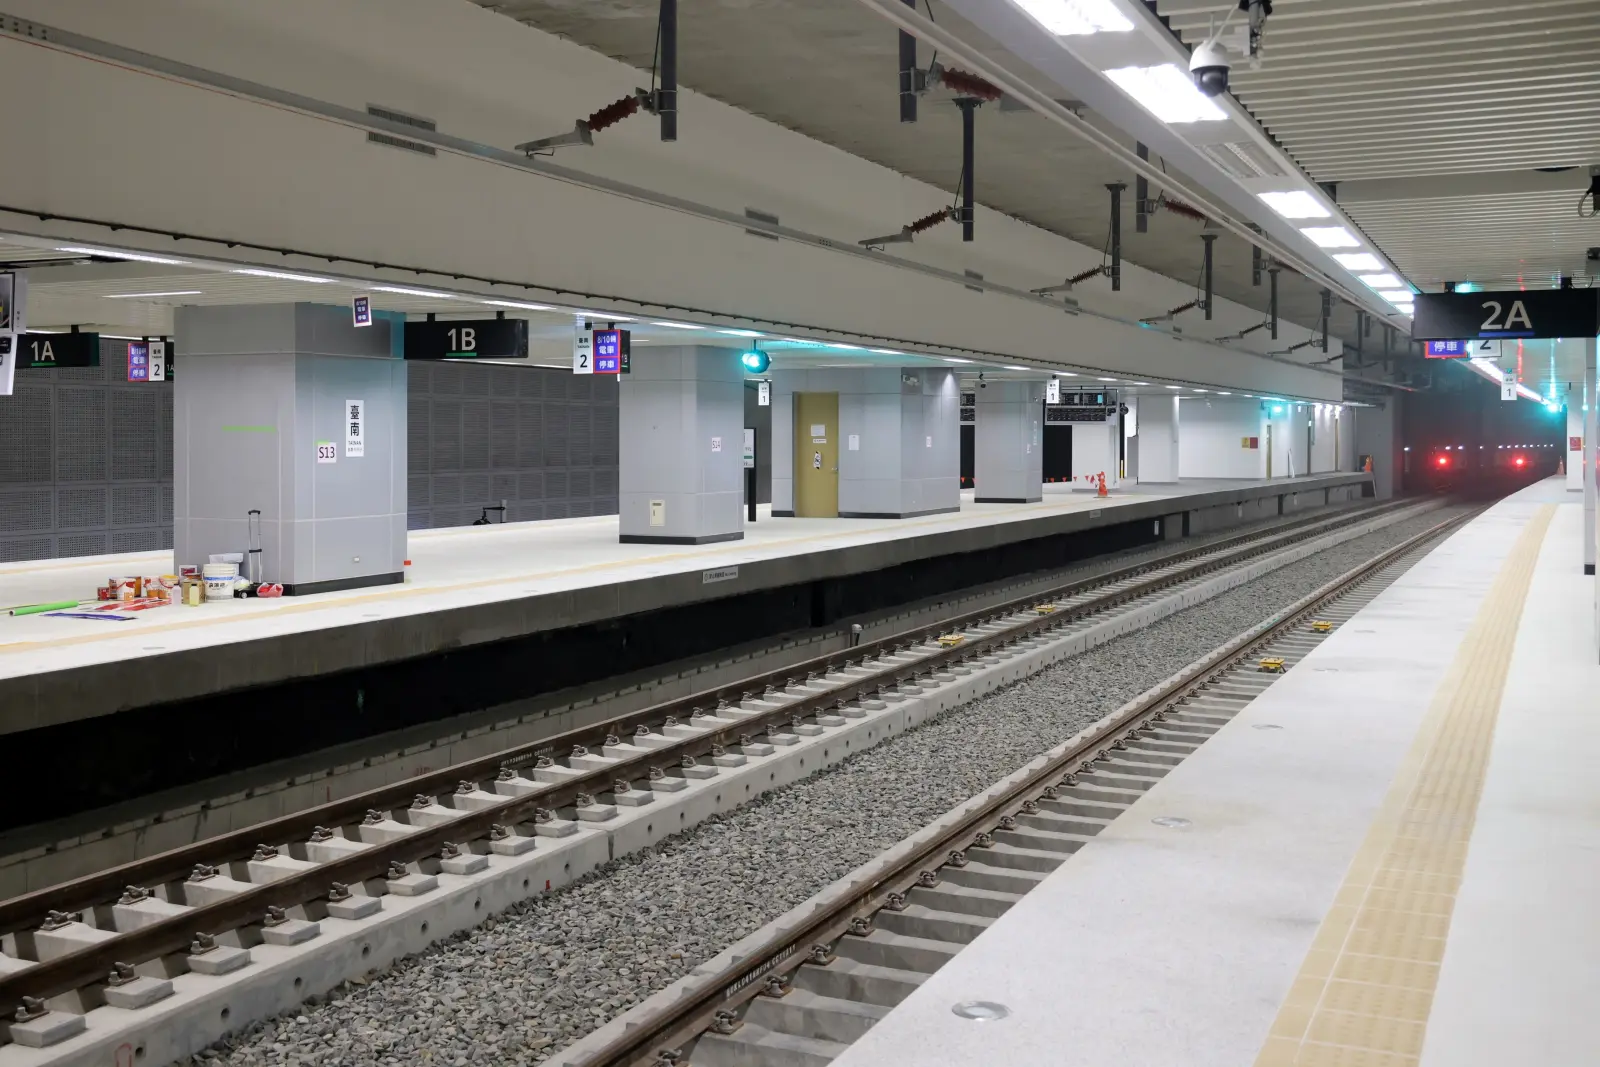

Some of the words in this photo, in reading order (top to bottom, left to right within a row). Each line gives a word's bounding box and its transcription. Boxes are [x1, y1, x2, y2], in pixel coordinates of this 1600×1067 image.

[1480, 300, 1532, 330] 2A
[448, 328, 476, 351] 1B
[31, 340, 55, 361] 1A
[599, 345, 615, 355] 電車
[1434, 341, 1458, 352] 停車
[580, 354, 588, 368] 2
[599, 360, 615, 369] 停車
[154, 364, 160, 376] 2
[1051, 393, 1055, 401] 1
[1506, 388, 1512, 397] 1
[762, 395, 766, 403] 1
[350, 405, 360, 437] 臺南
[318, 446, 336, 459] S13
